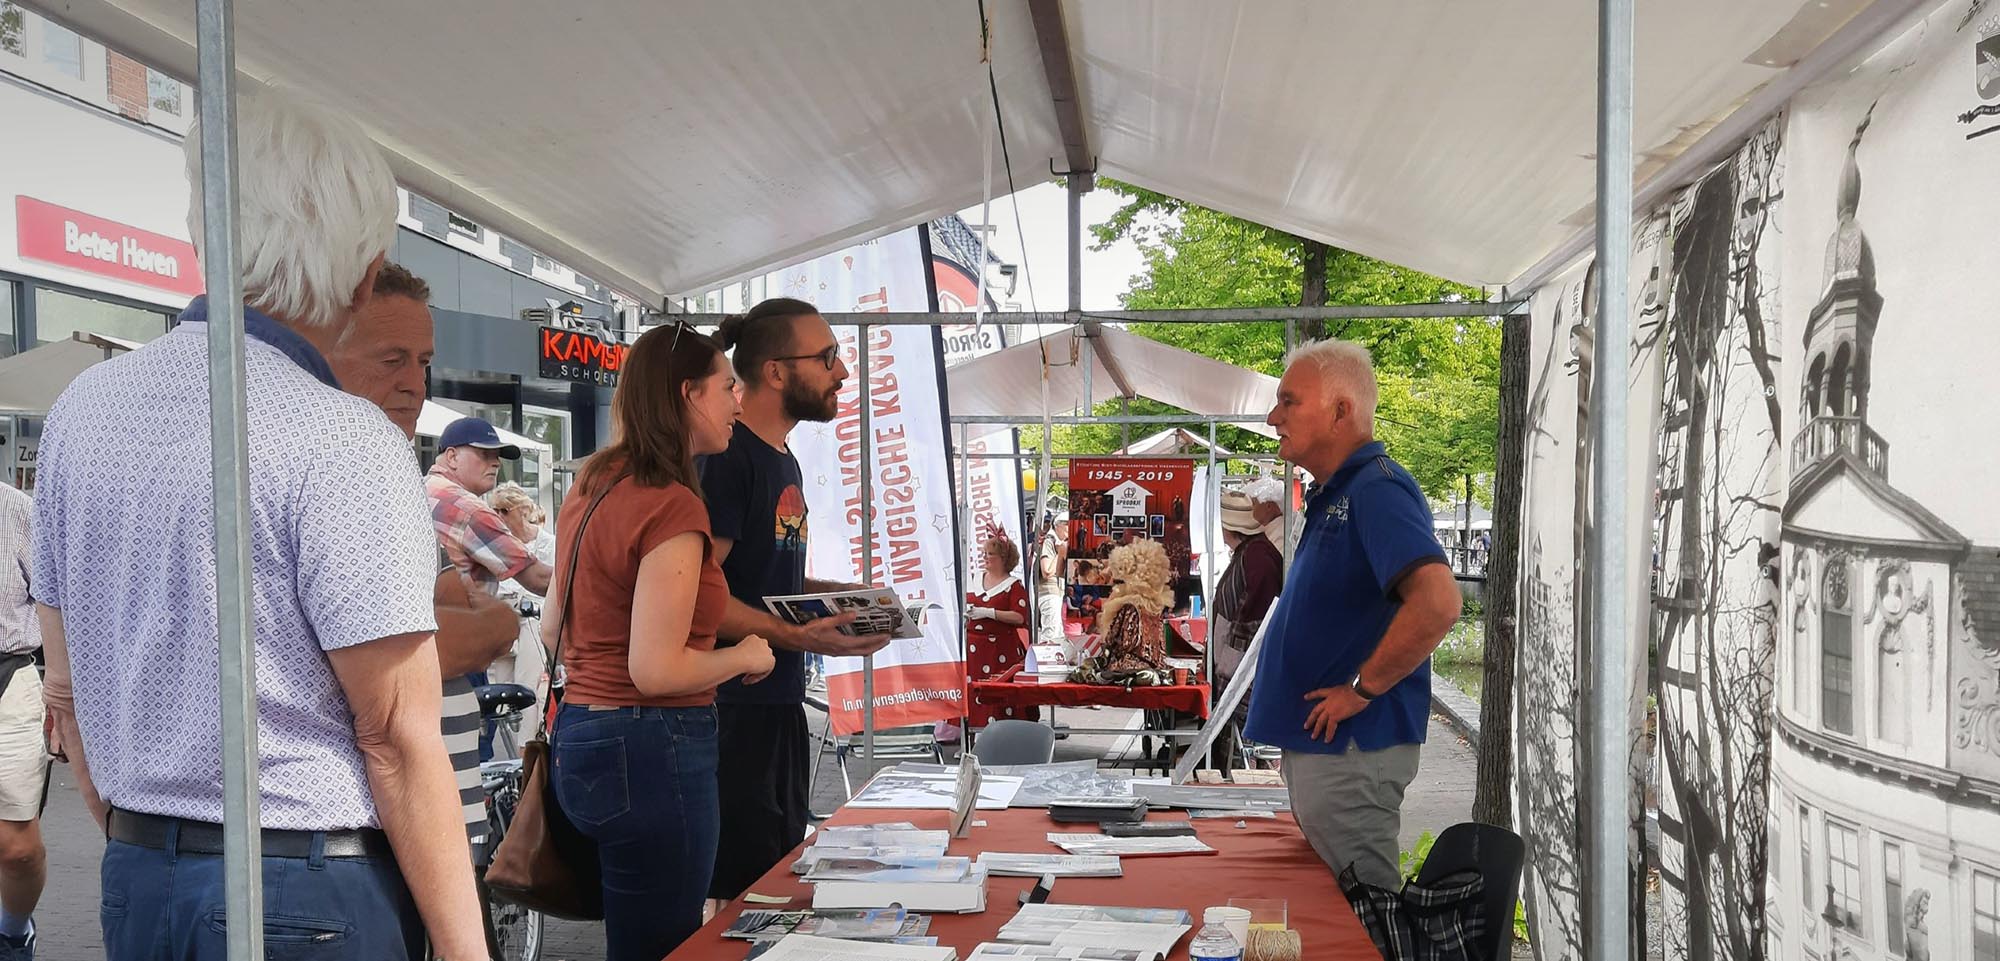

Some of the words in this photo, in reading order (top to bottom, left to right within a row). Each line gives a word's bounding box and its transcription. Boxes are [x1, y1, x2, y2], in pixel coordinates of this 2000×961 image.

[64, 220, 119, 263] Beter
[122, 236, 178, 278] Horen
[1088, 470, 1123, 481] 1945
[1136, 471, 1174, 481] 2019
